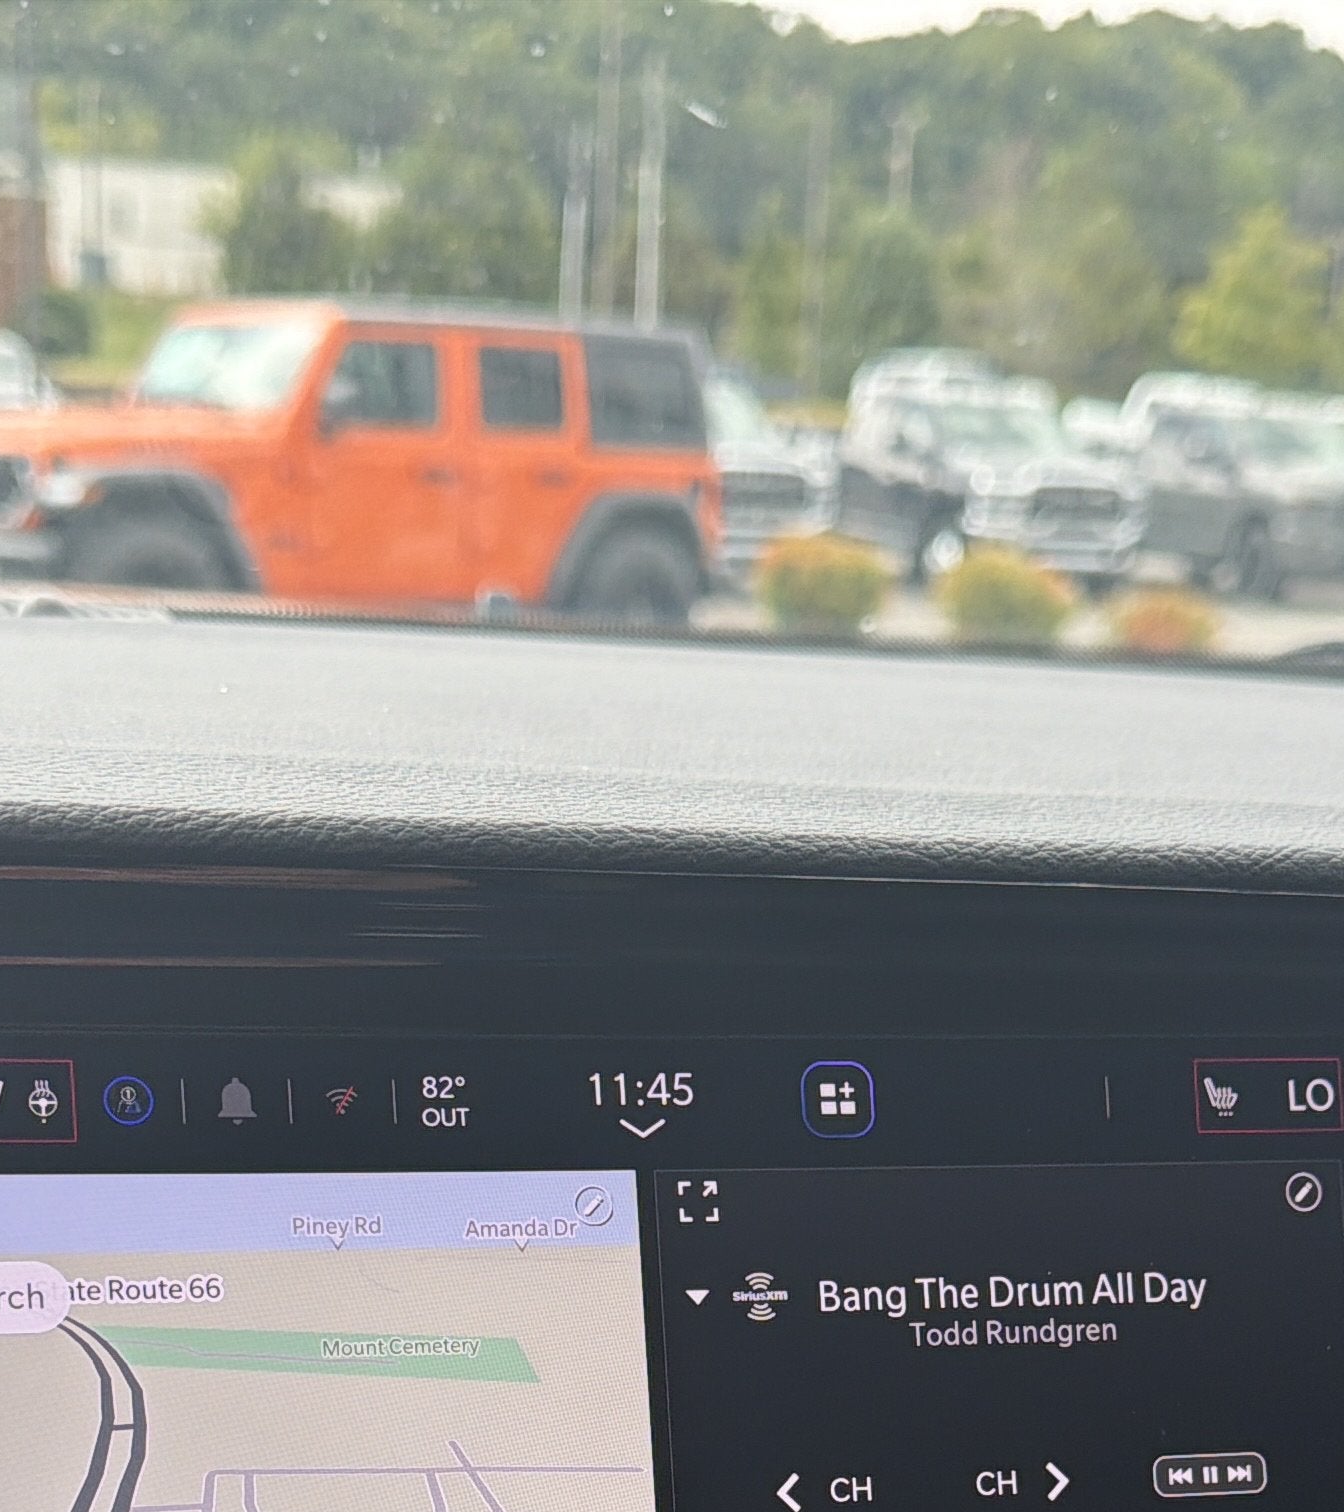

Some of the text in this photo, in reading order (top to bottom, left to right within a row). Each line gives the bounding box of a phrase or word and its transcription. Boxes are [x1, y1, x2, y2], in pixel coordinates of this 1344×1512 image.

[422, 1075, 466, 1099] 82°
[589, 1072, 694, 1107] 11:45
[1287, 1078, 1335, 1112] LO
[421, 1107, 470, 1127] OUT
[292, 1215, 382, 1240] Piney Rd
[465, 1217, 577, 1239] Amanda Dr
[108, 1278, 183, 1301] Route
[189, 1276, 222, 1301] 66
[818, 1271, 1207, 1318] Bang The Drum All Day
[908, 1317, 1117, 1348] Todd Rundgren
[323, 1337, 479, 1359] Mount Cemetery
[830, 1476, 873, 1503] CH
[975, 1470, 1018, 1496] CH
